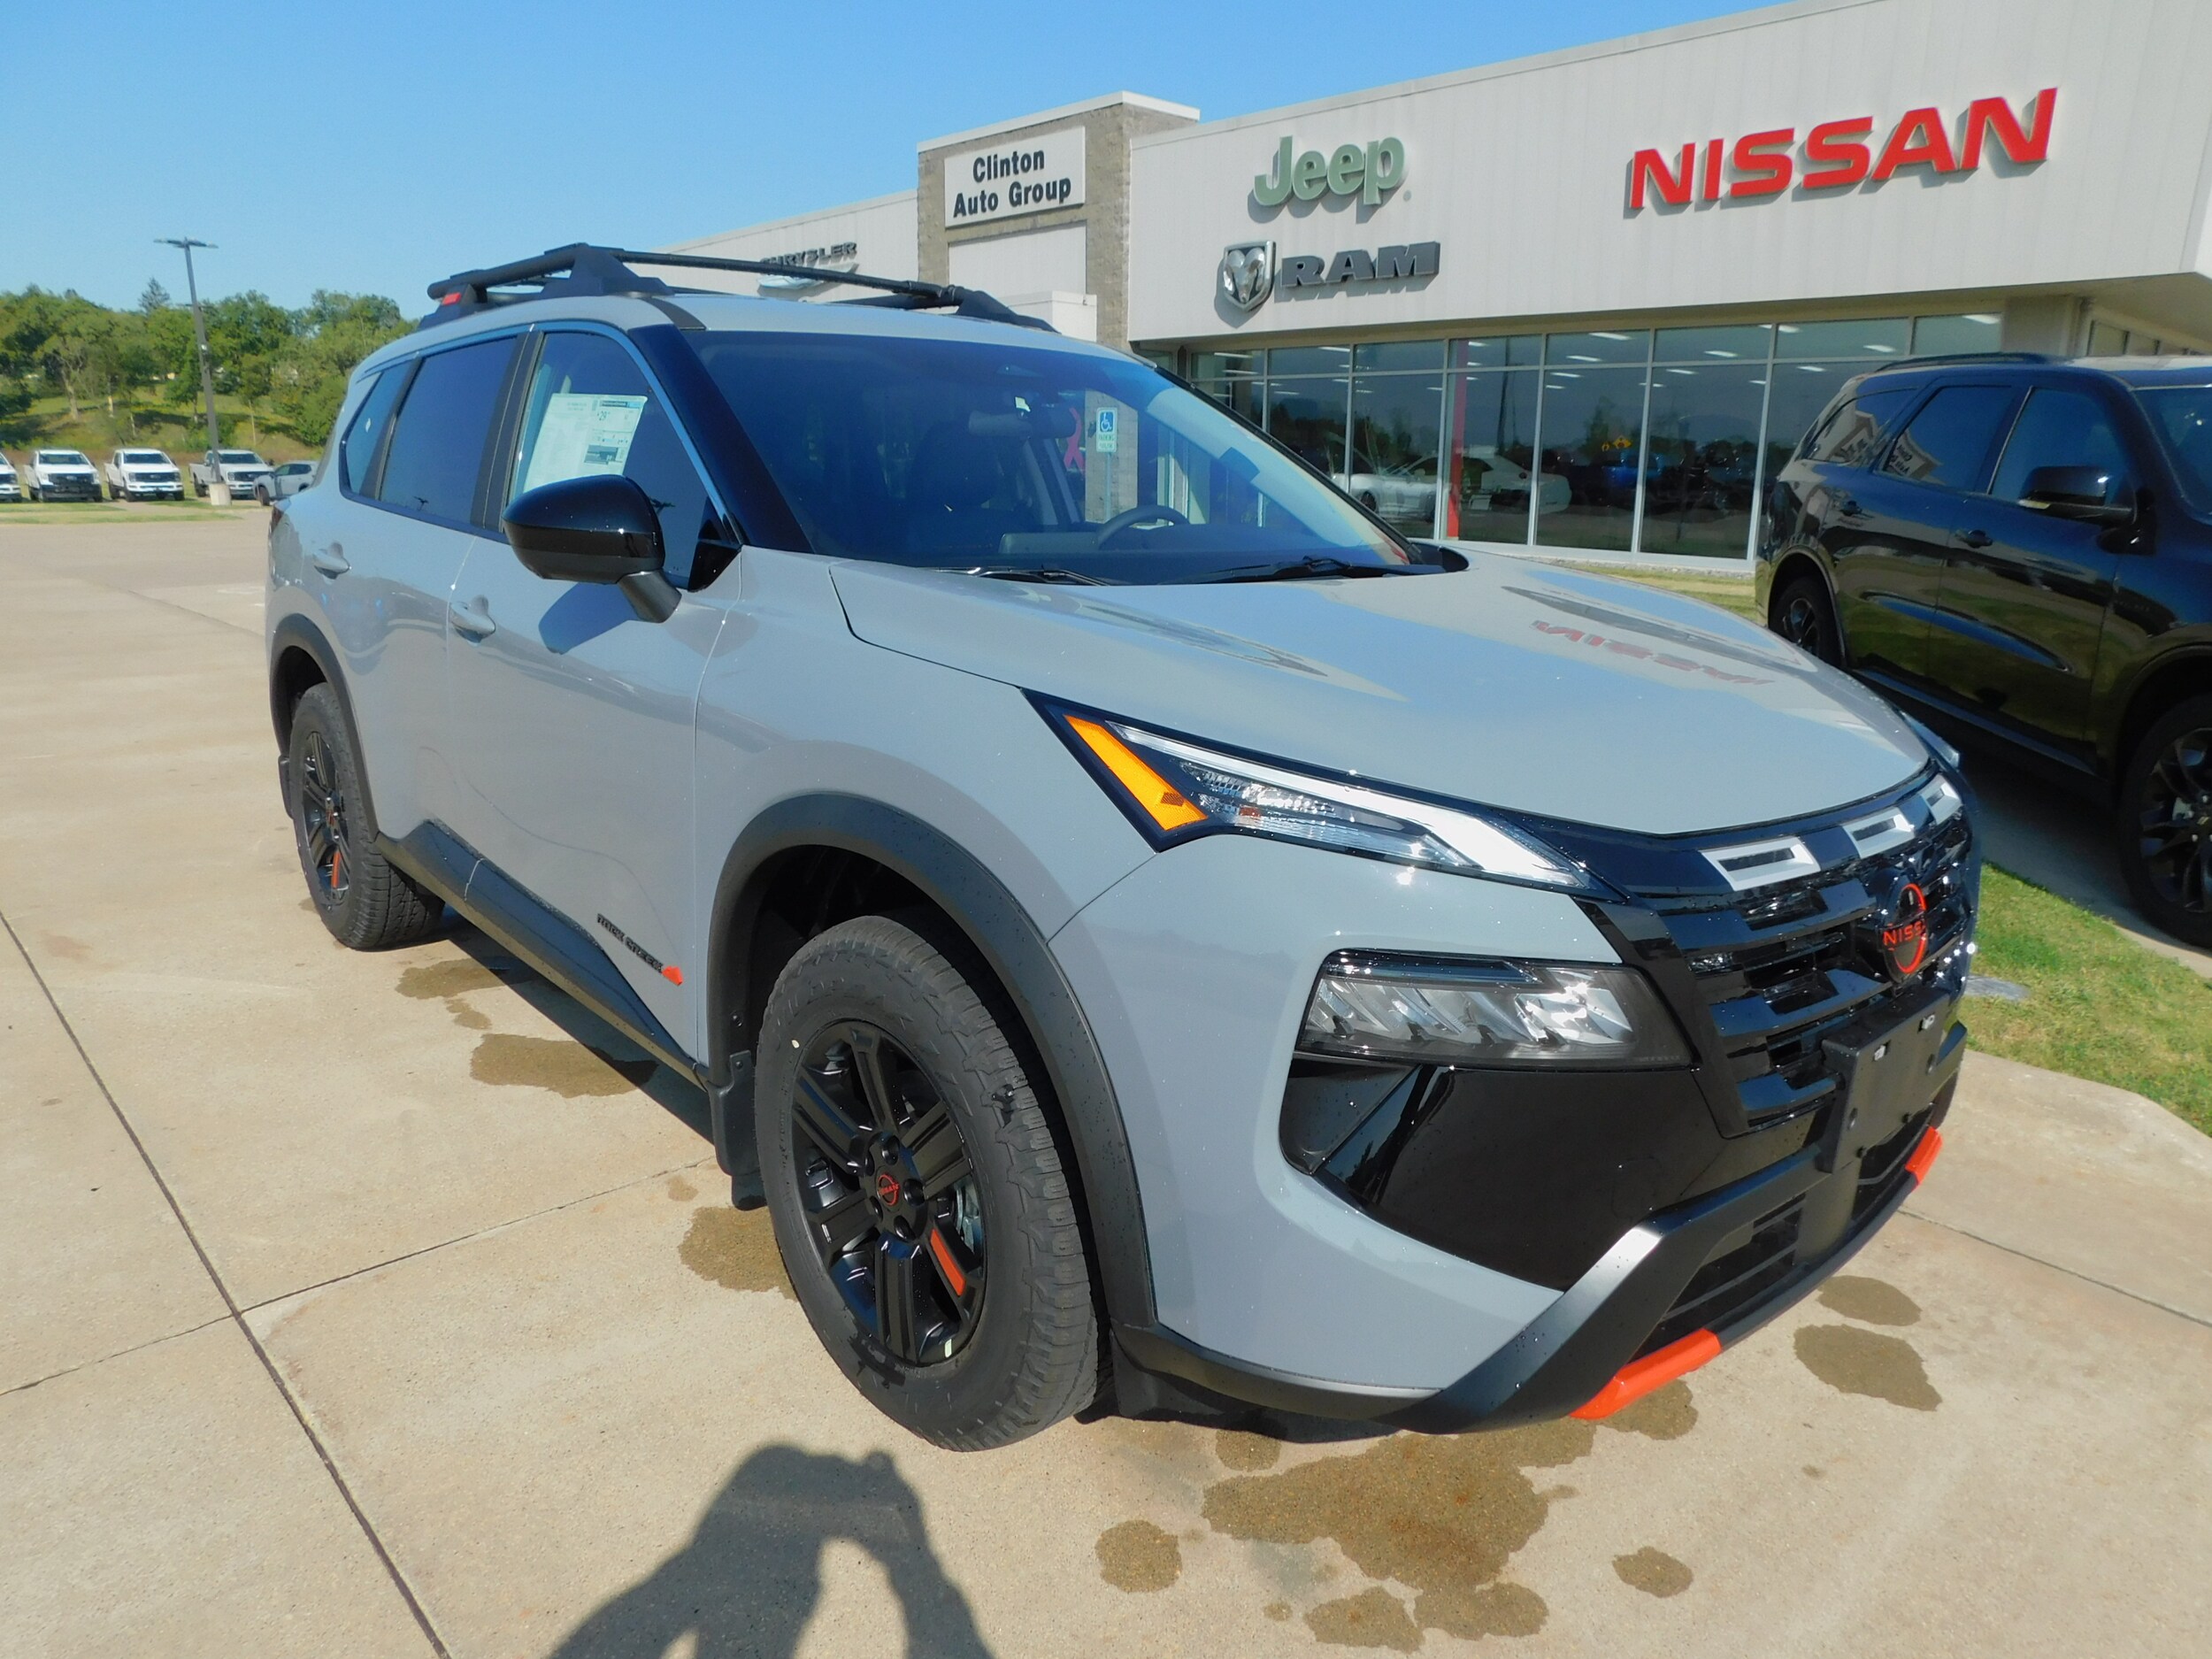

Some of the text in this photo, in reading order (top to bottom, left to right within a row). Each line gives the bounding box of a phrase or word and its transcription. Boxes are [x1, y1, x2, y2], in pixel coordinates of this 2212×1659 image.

[973, 150, 1045, 183] Clinton
[1254, 135, 1405, 206] Jeep
[1630, 87, 2058, 210] NISSAN
[953, 177, 1071, 219] Auto Group
[1281, 241, 1440, 288] RAM
[1883, 920, 1926, 947] NISS
